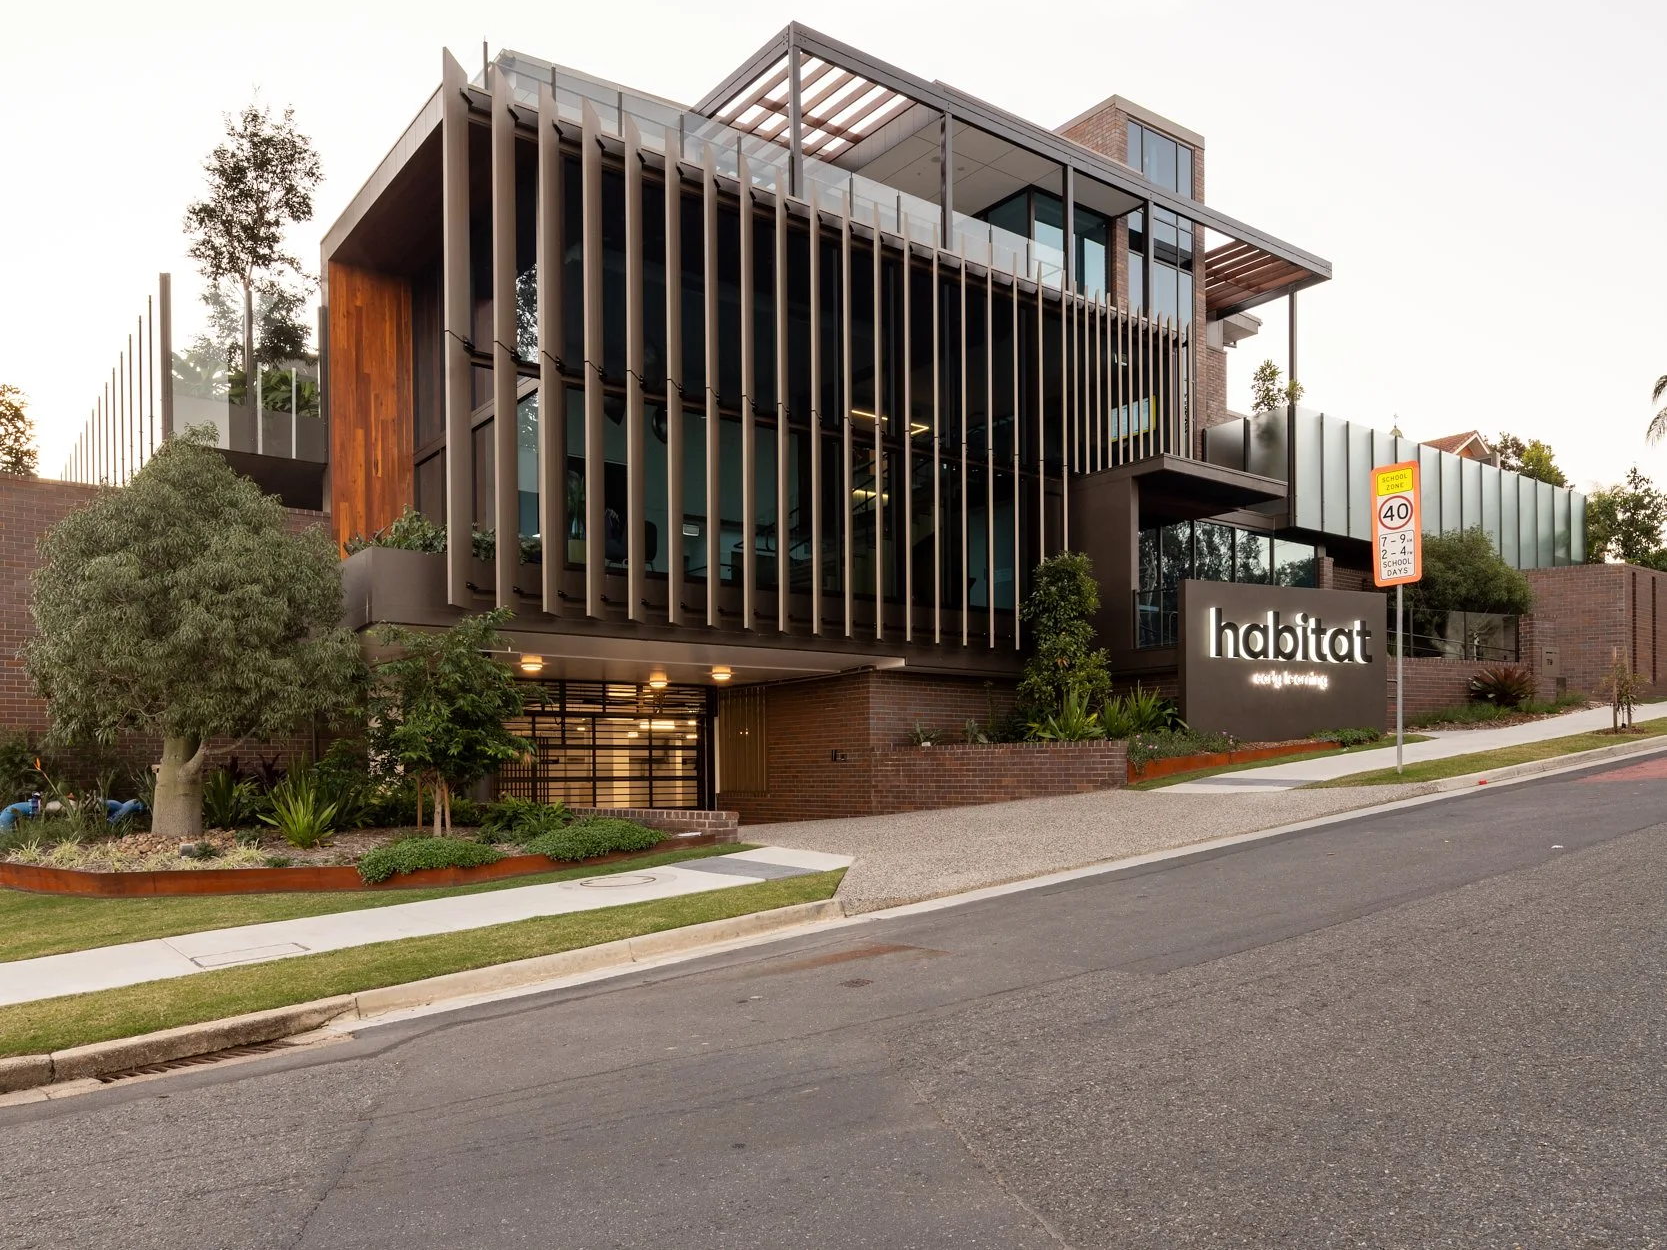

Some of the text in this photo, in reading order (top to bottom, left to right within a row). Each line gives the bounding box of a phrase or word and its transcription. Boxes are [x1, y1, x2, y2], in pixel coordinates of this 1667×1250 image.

[1382, 473, 1408, 483] SCHOOL
[1386, 482, 1405, 491] ZONE
[1382, 503, 1409, 521] 40
[1382, 558, 1412, 569] SCHOOL
[1387, 567, 1409, 577] DAYS
[1209, 607, 1373, 664] habitat
[1251, 670, 1328, 690] early learning
